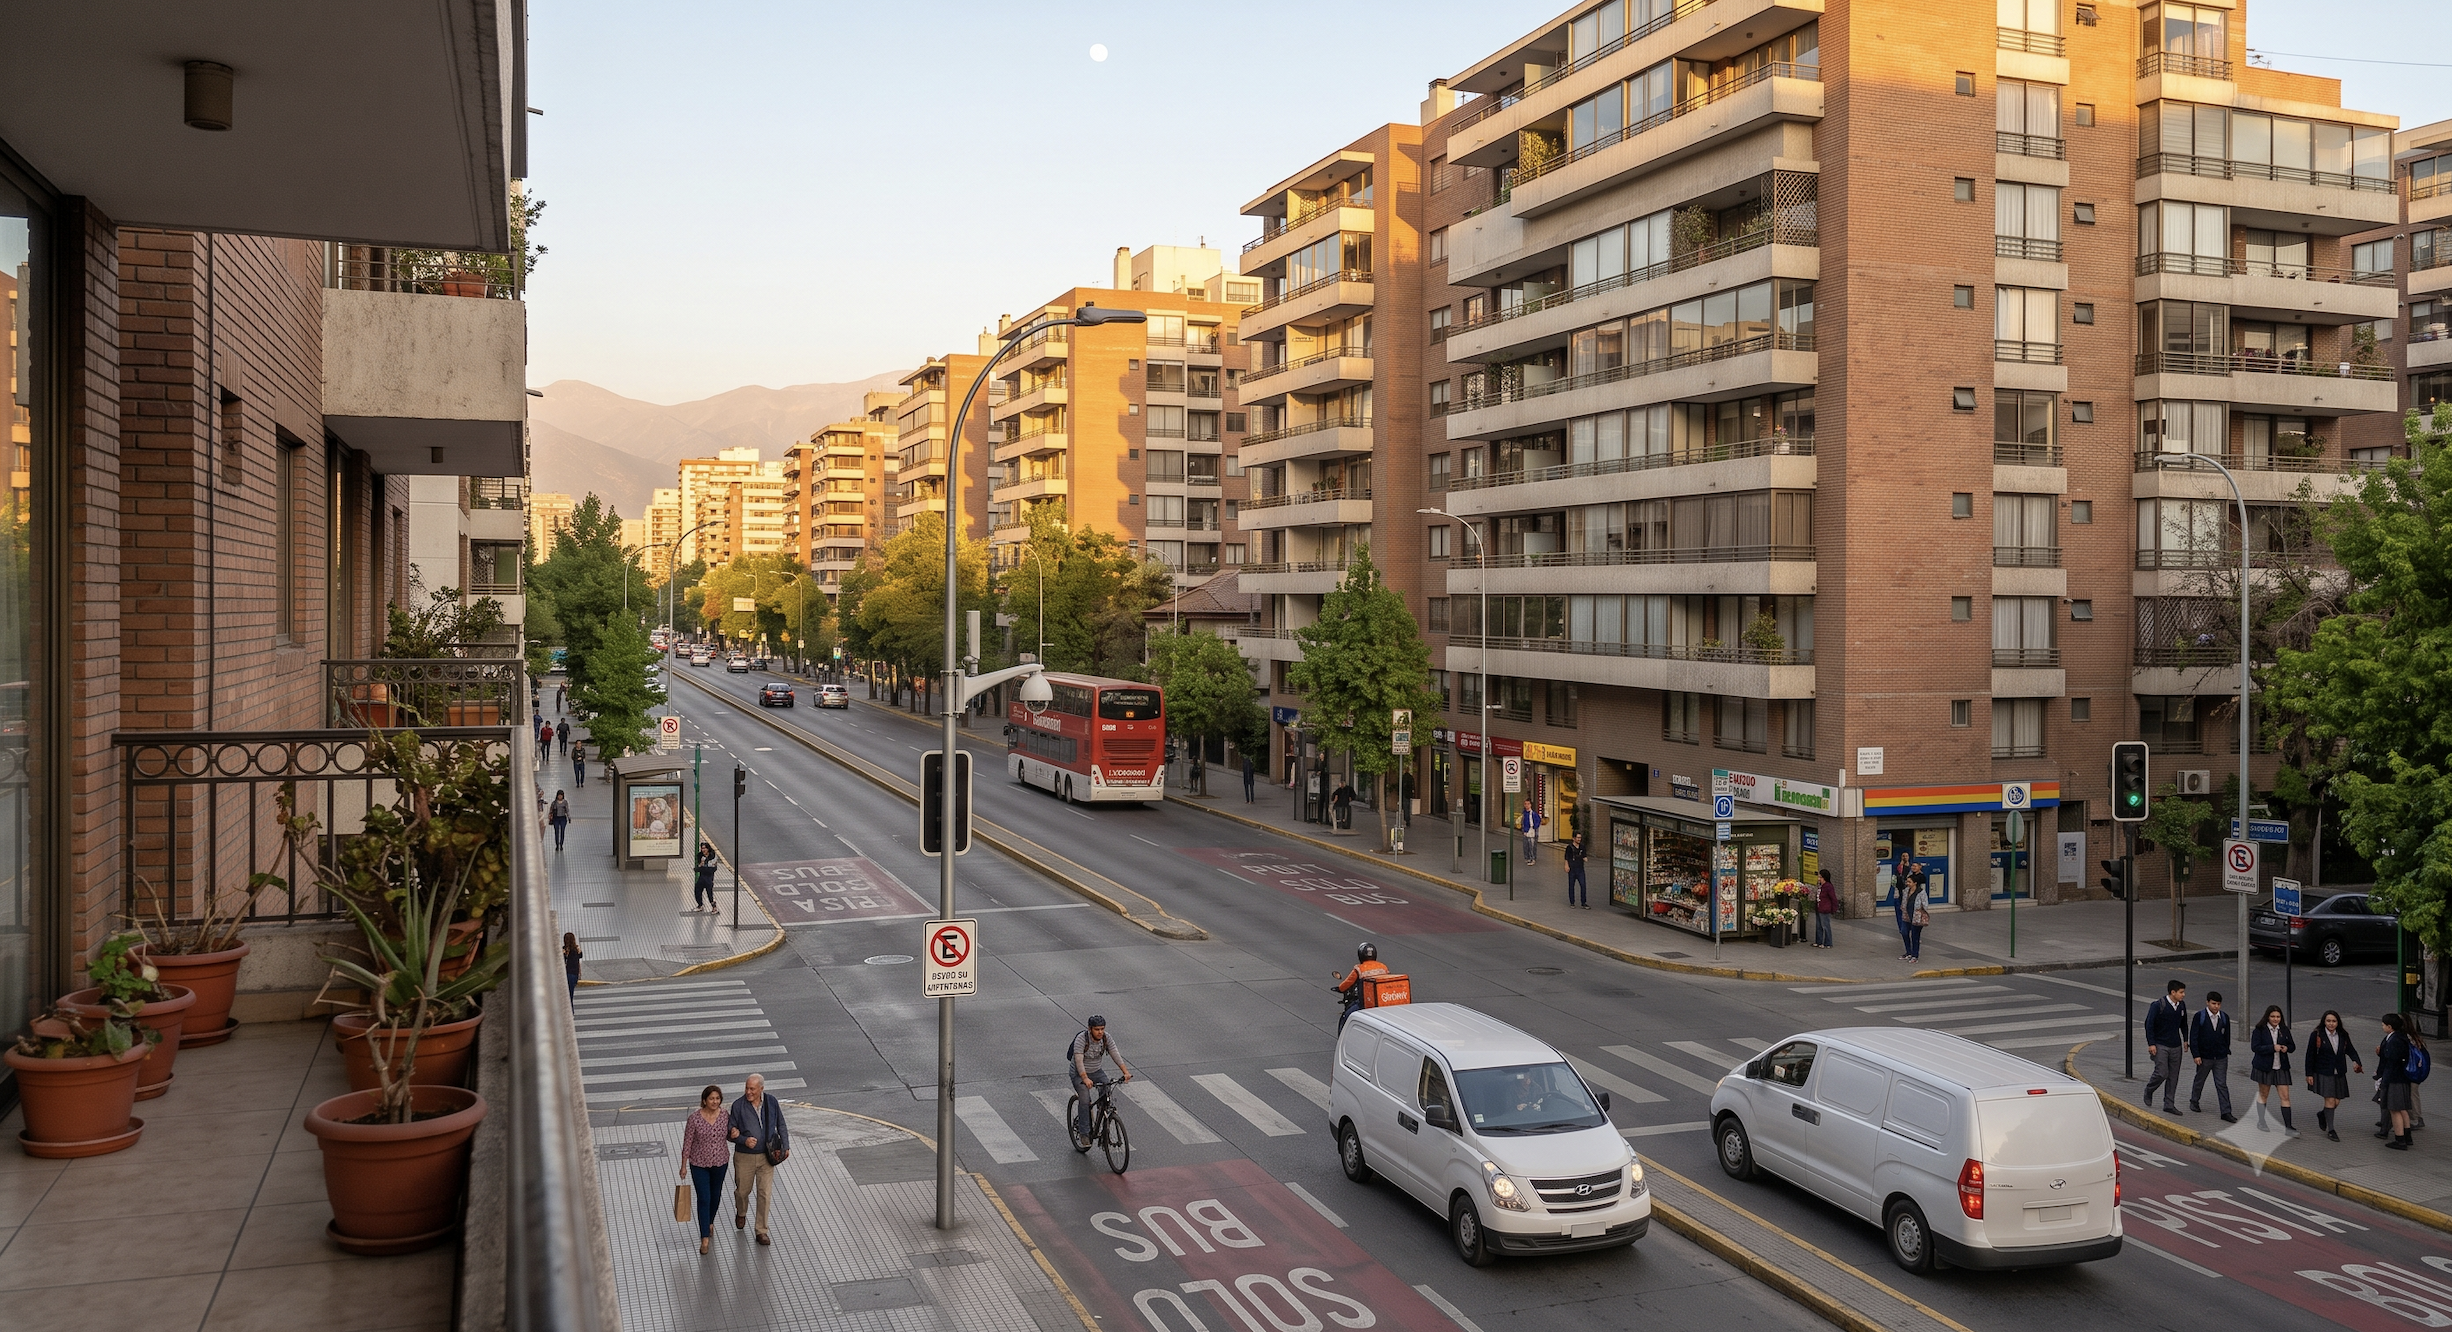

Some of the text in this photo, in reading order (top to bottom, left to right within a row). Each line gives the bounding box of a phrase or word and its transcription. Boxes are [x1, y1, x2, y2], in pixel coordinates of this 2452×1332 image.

[772, 865, 844, 880] BUS
[1324, 892, 1409, 905] BUS
[940, 934, 958, 959] E
[1089, 1199, 1266, 1262] BUS
[2121, 1186, 2370, 1248] PISTA
[2293, 1255, 2452, 1328] BU
